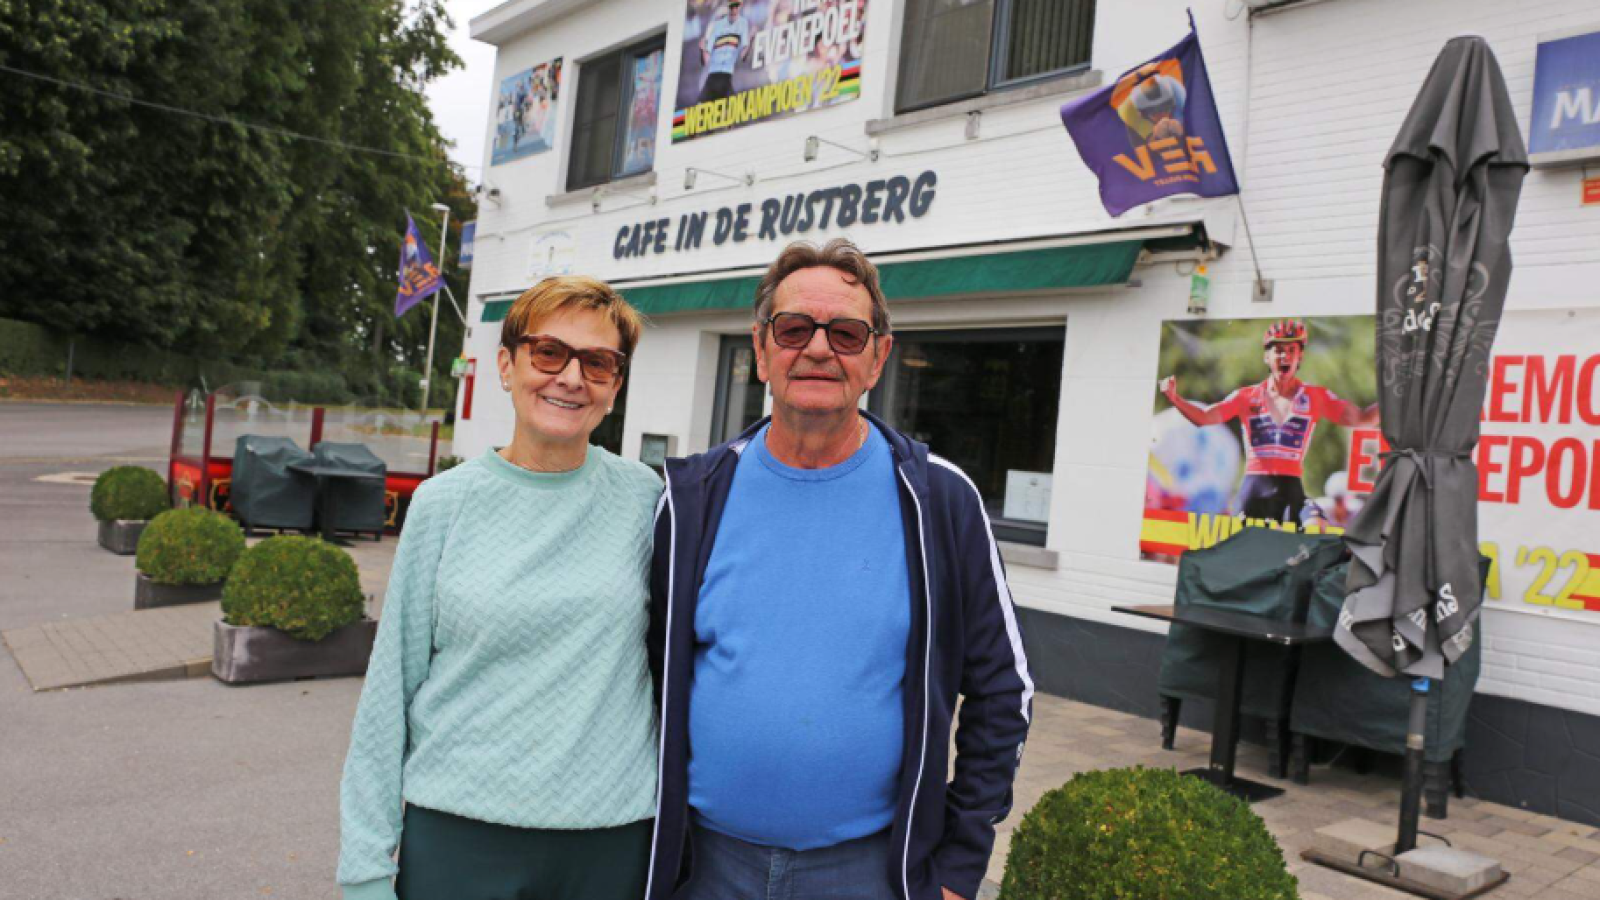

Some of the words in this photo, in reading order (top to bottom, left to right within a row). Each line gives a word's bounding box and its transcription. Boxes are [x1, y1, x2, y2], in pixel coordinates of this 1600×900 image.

[751, 3, 861, 69] EVENEPOEL
[684, 73, 814, 136] WERELDKAMPIOEN
[613, 217, 670, 260] CAFE
[674, 211, 708, 251] IN
[713, 202, 752, 246] DE
[758, 170, 937, 241] RUSTBERG
